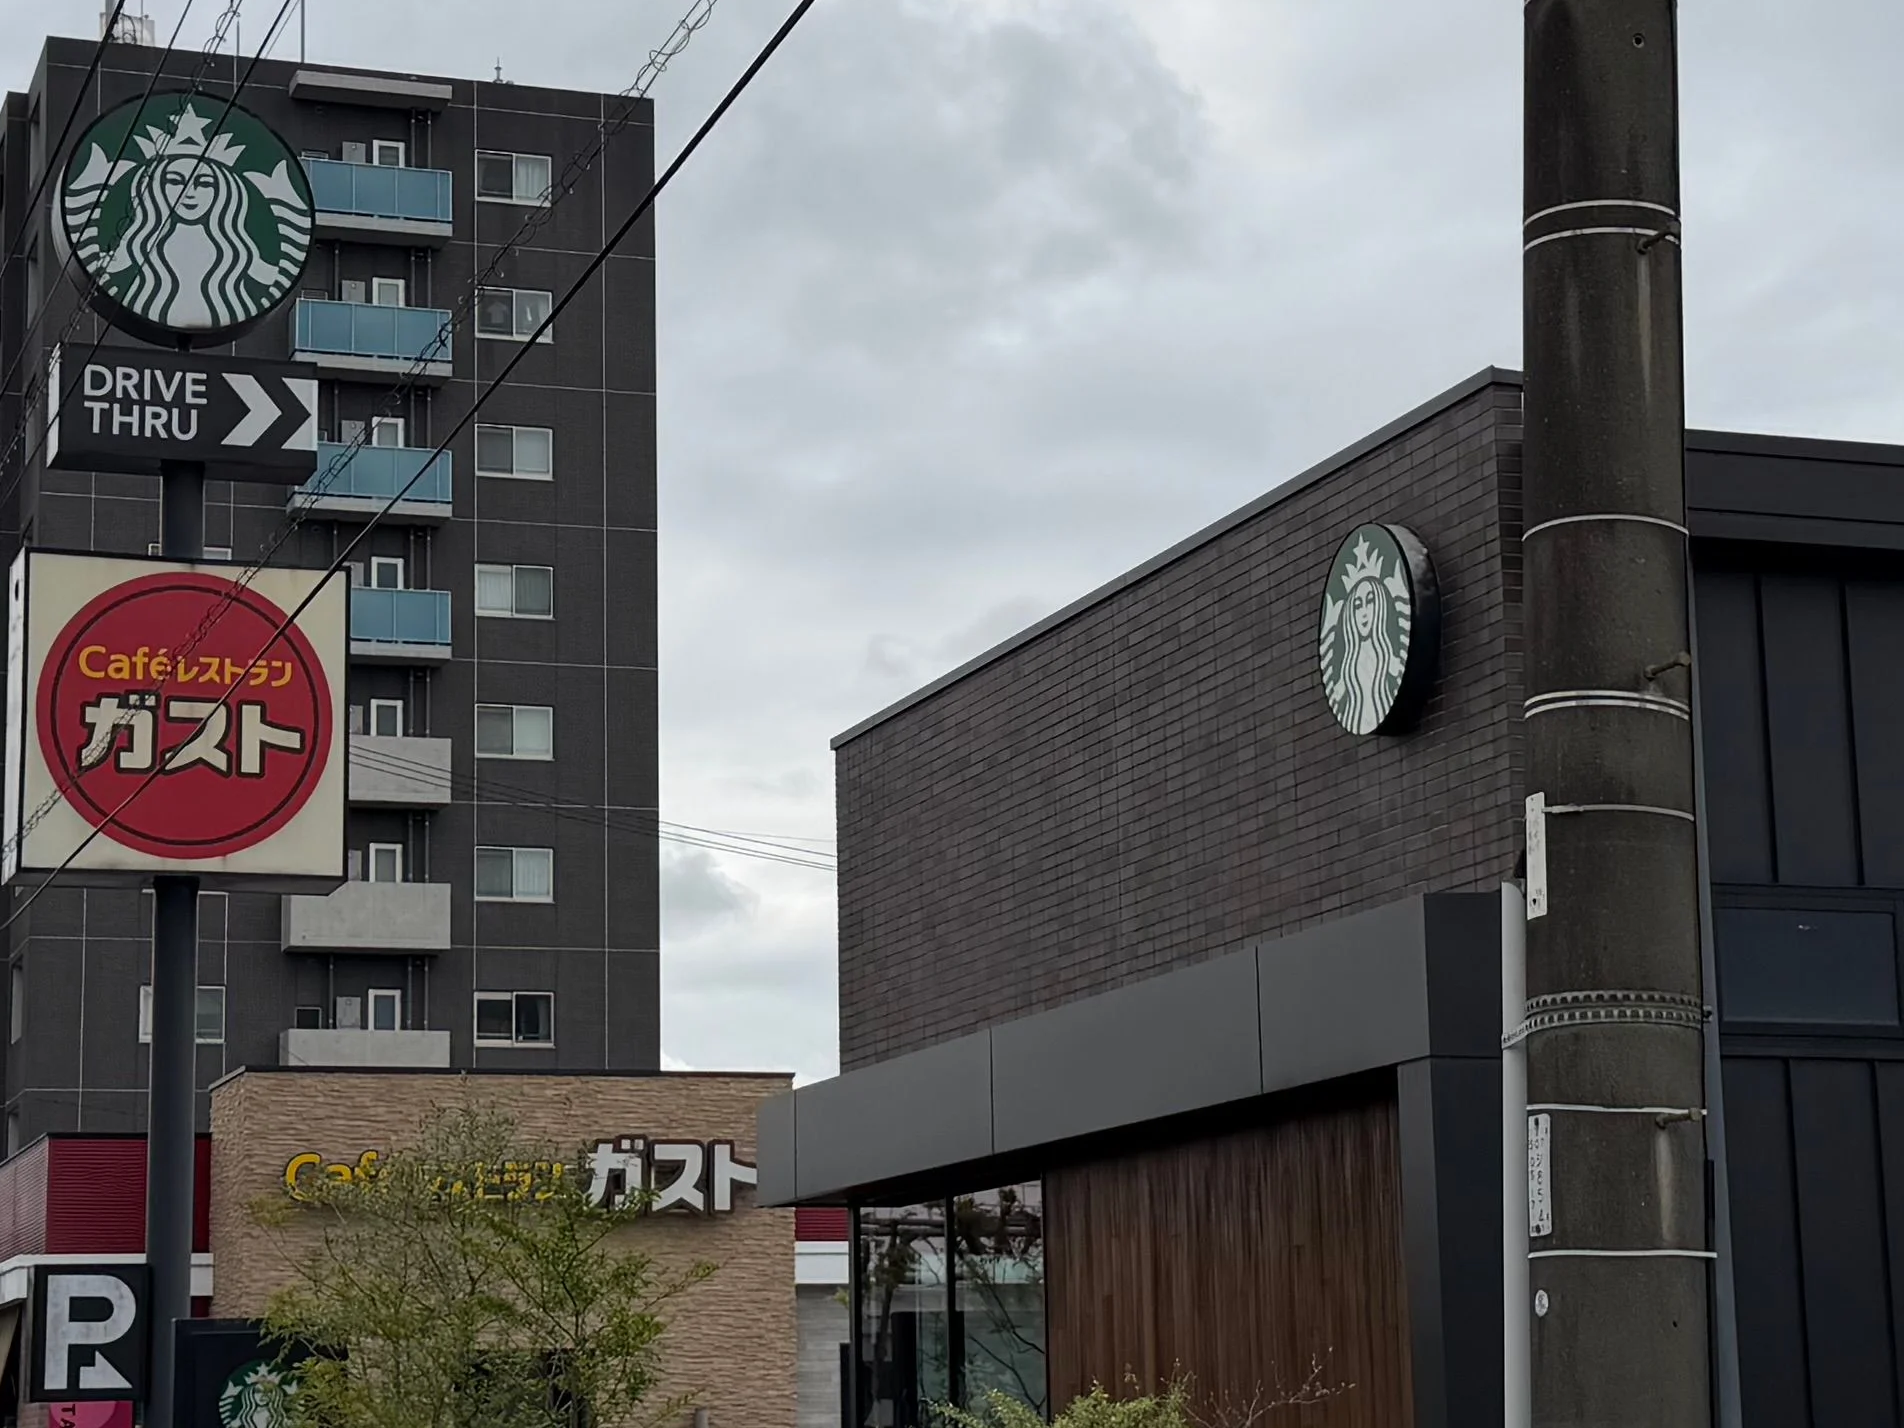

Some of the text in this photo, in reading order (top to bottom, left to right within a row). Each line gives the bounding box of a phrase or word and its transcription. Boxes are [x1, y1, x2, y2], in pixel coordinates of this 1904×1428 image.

[83, 364, 207, 405] DRIVE
[83, 400, 198, 441] THRU
[79, 691, 303, 776] ガスト
